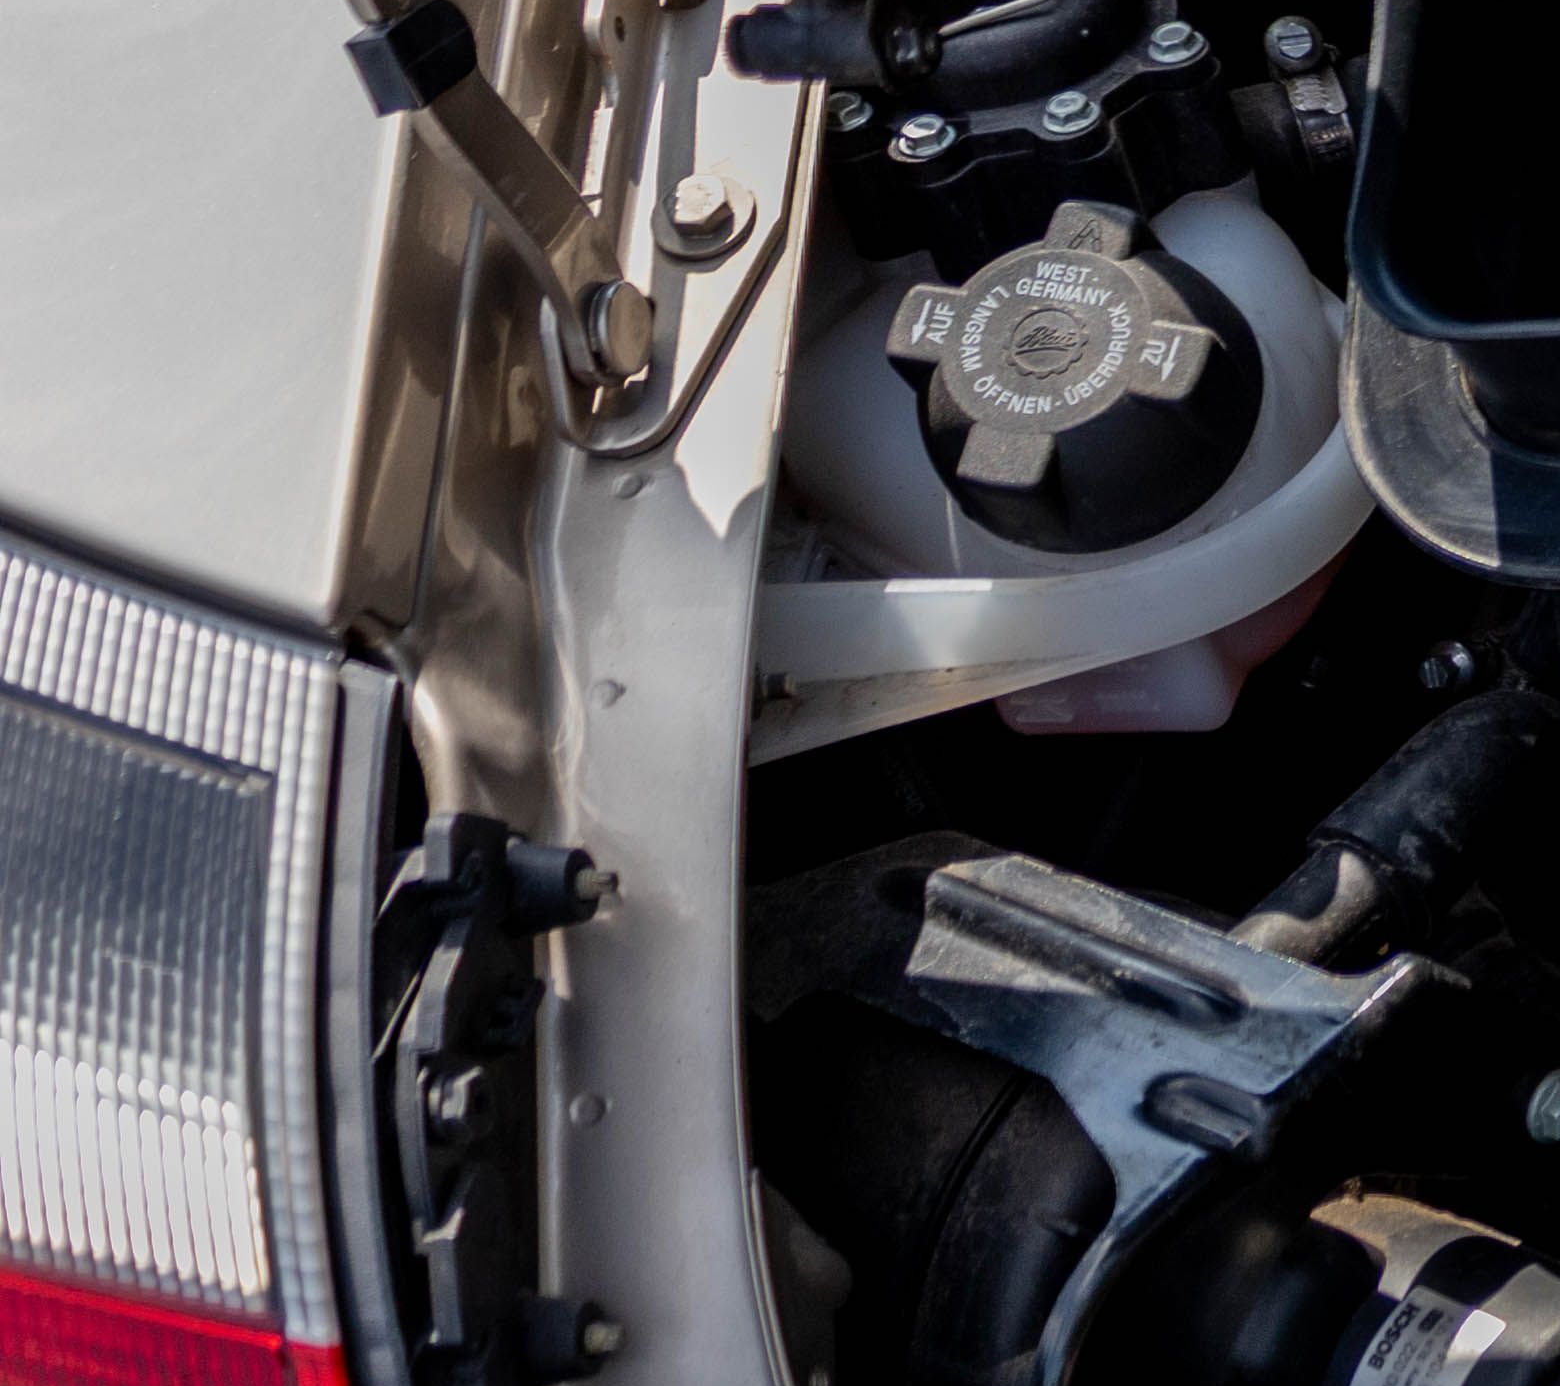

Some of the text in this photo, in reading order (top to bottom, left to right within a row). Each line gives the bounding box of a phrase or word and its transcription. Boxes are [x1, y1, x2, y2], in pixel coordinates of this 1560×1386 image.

[1015, 278, 1113, 309] GERMANY
[925, 303, 957, 345] AUF
[959, 284, 1011, 376] LANGSAM
[1139, 340, 1167, 368] ZU
[1367, 1303, 1421, 1370] BOSCH
